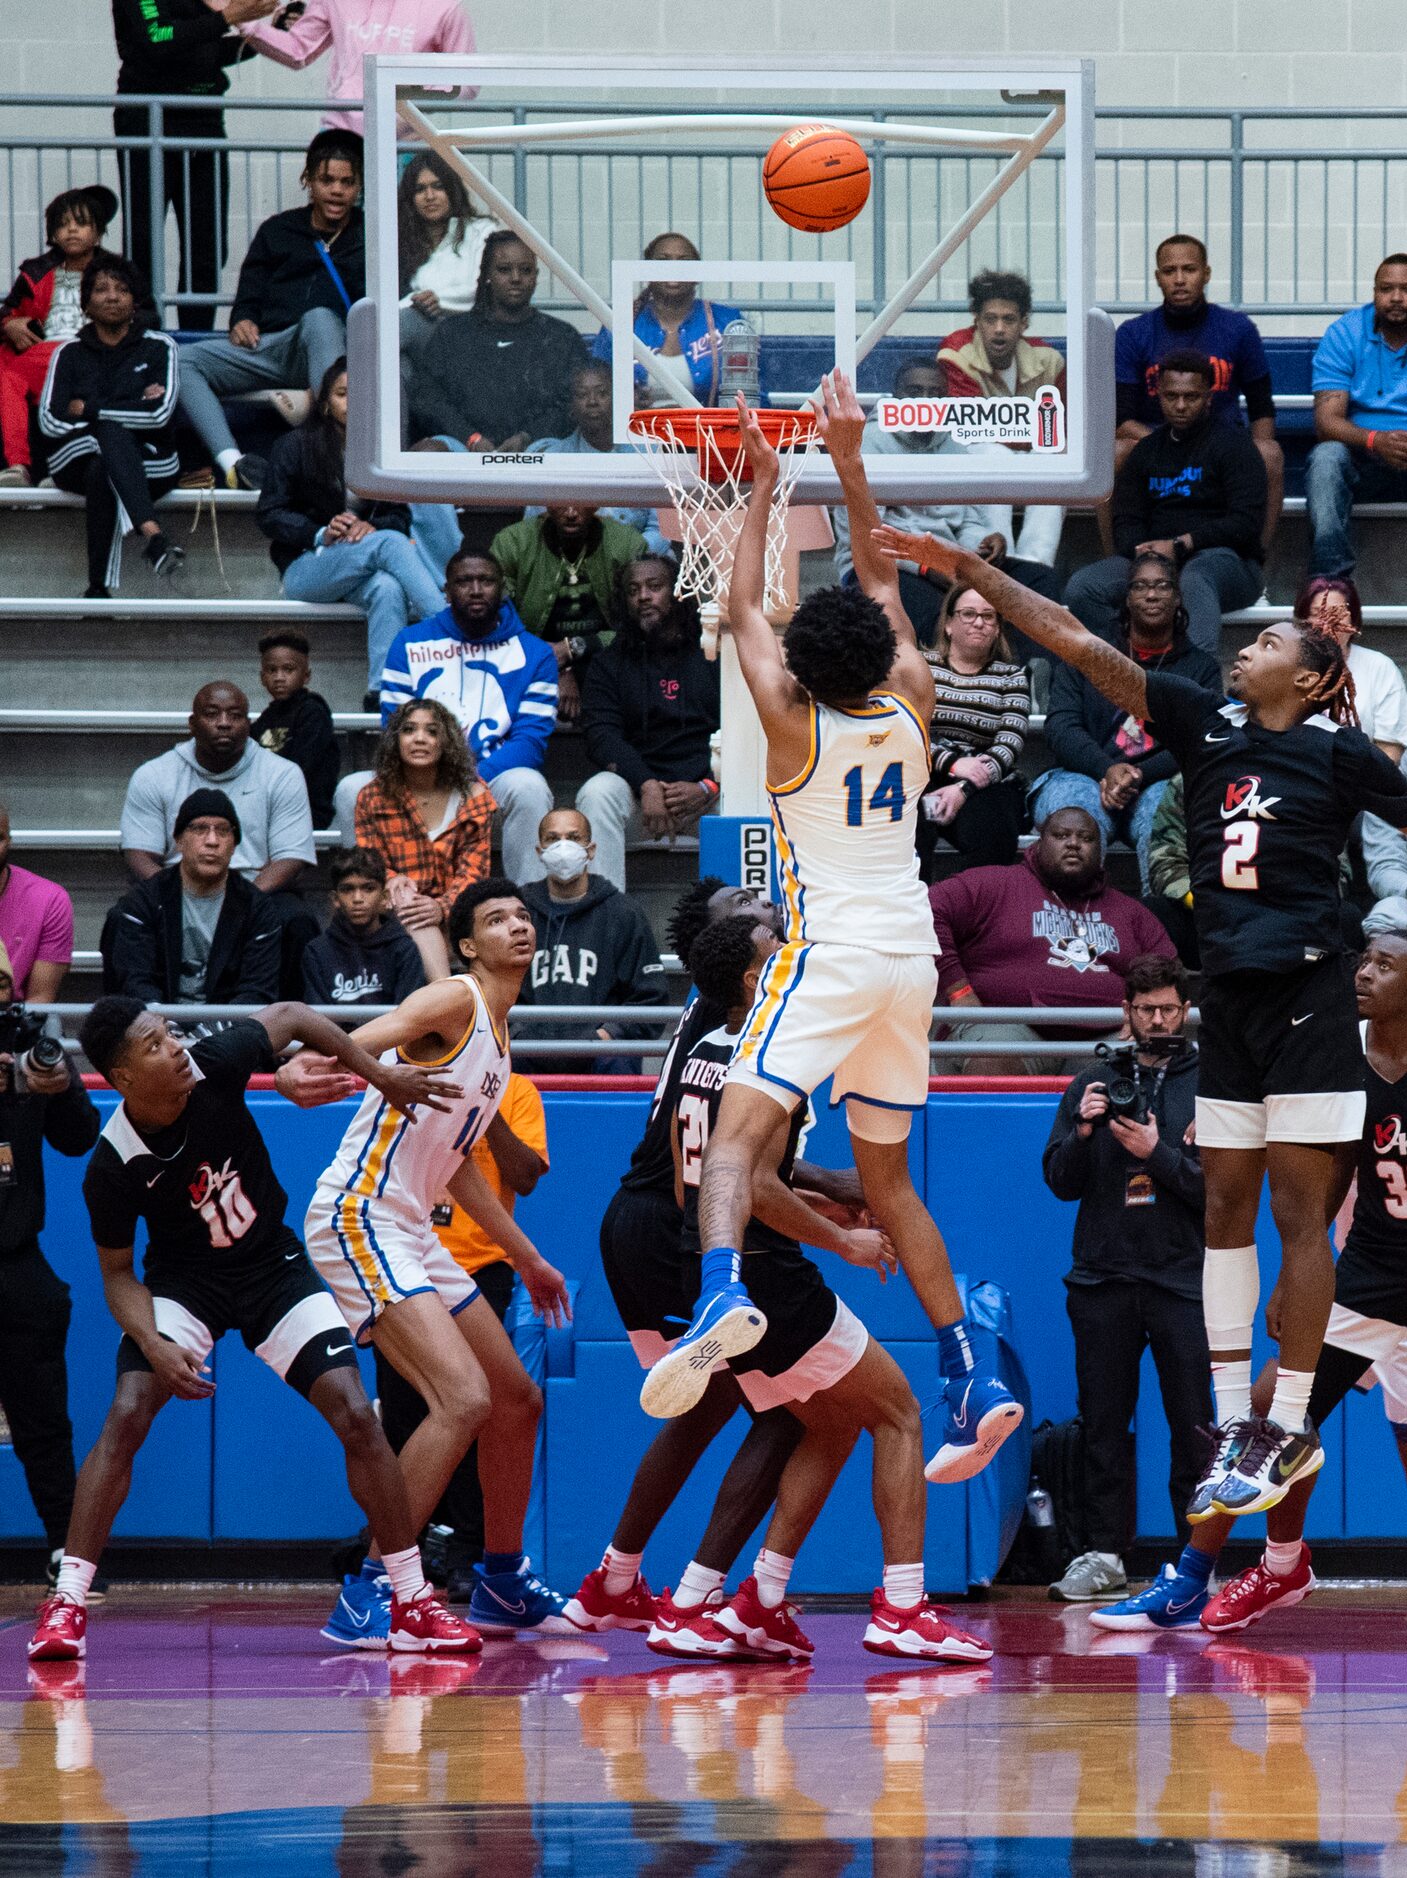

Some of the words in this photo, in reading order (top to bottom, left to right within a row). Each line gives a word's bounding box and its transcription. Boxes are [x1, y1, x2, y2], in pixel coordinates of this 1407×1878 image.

[883, 403, 1031, 427] BODYARMOR
[957, 428, 995, 439] Sports
[1000, 427, 1031, 437] Drink
[937, 711, 979, 725] GUESS
[843, 761, 907, 827] 14
[1222, 820, 1261, 890] 2
[531, 944, 598, 989] GAP
[200, 1175, 258, 1249] 10
